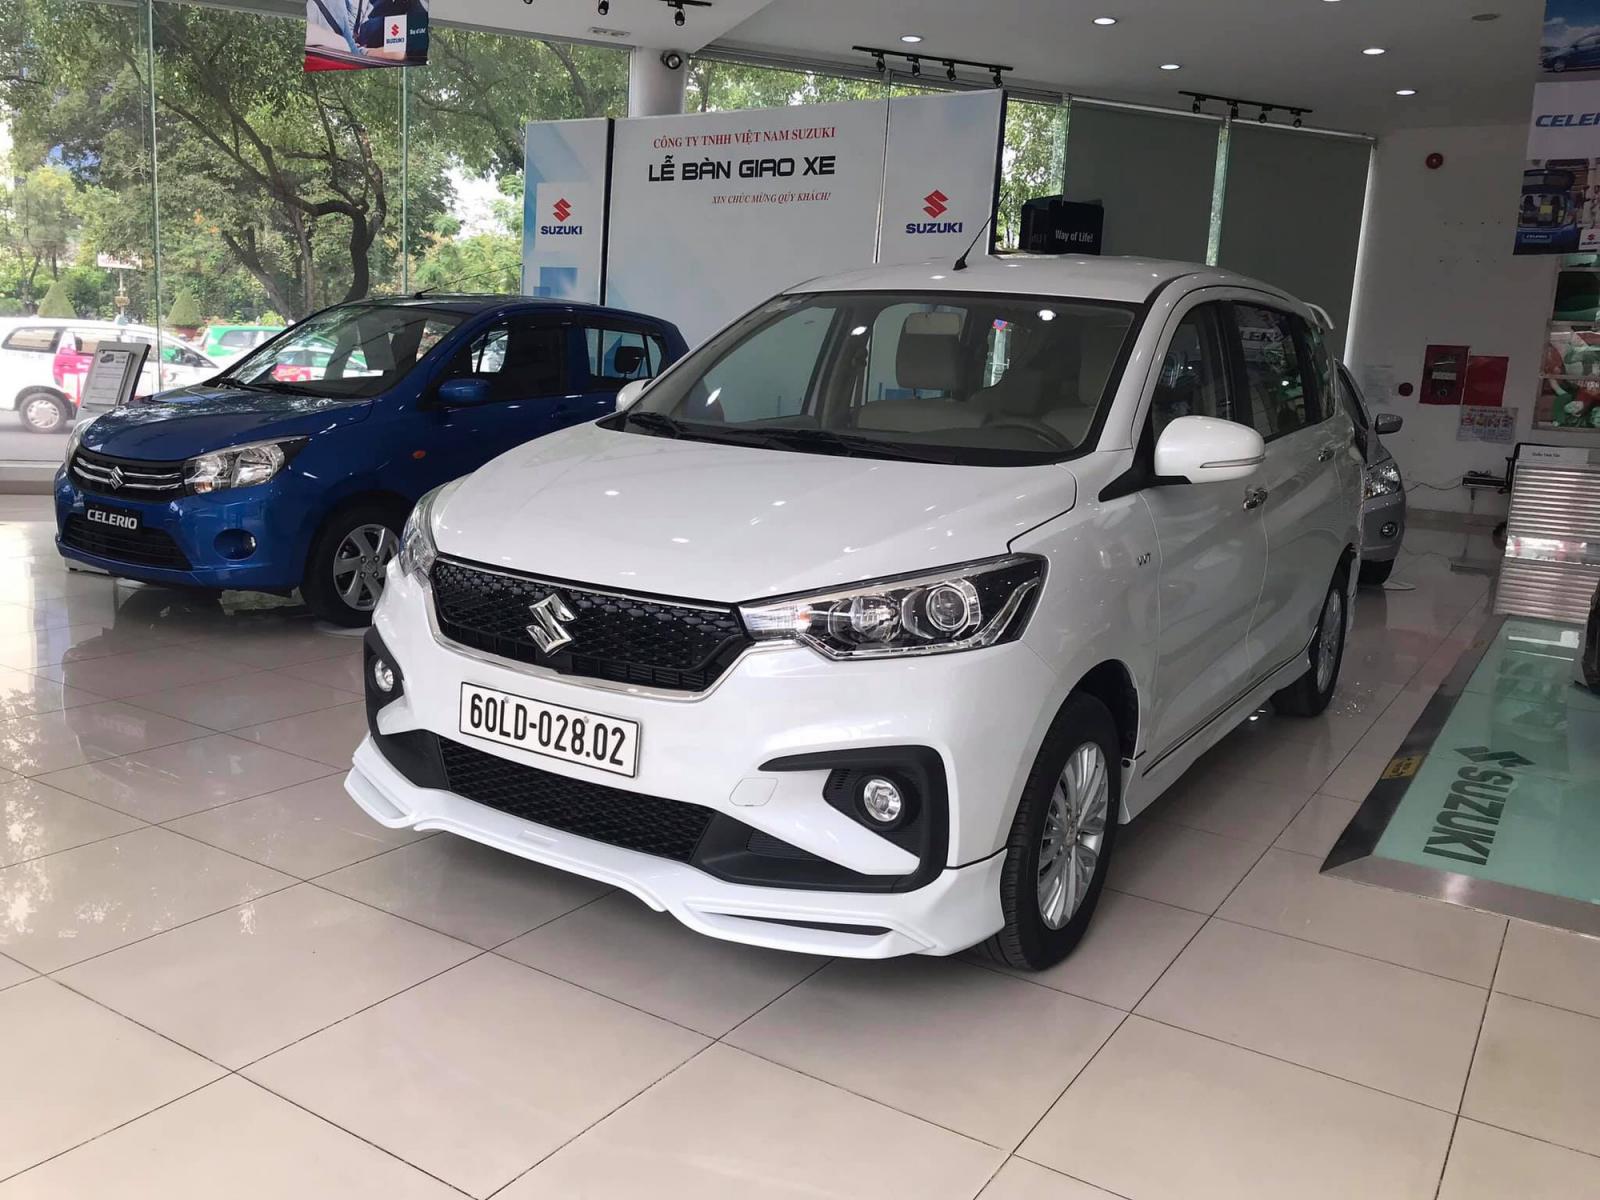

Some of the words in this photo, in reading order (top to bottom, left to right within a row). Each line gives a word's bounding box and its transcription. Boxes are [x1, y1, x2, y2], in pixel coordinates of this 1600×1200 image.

[653, 135, 683, 149] CÔNG
[685, 135, 700, 148] TY
[702, 133, 732, 146] TNHH
[735, 129, 762, 146] VIỆT
[763, 130, 789, 142] NAM
[791, 127, 837, 141] SUZUKI
[648, 154, 676, 182] LỄ
[681, 157, 731, 181] BÀN
[738, 157, 796, 179] GIAO
[802, 155, 837, 176] XE
[712, 195, 726, 204] XIN
[540, 225, 583, 235] SUZUKI
[905, 222, 963, 234] SUZUKI
[1055, 229, 1070, 242] Way
[1070, 231, 1078, 241] of
[1078, 231, 1094, 243] Life!
[87, 508, 138, 530] CELERIO
[470, 693, 626, 766] 60LD-028.02
[1422, 765, 1515, 866] SUZUKI
